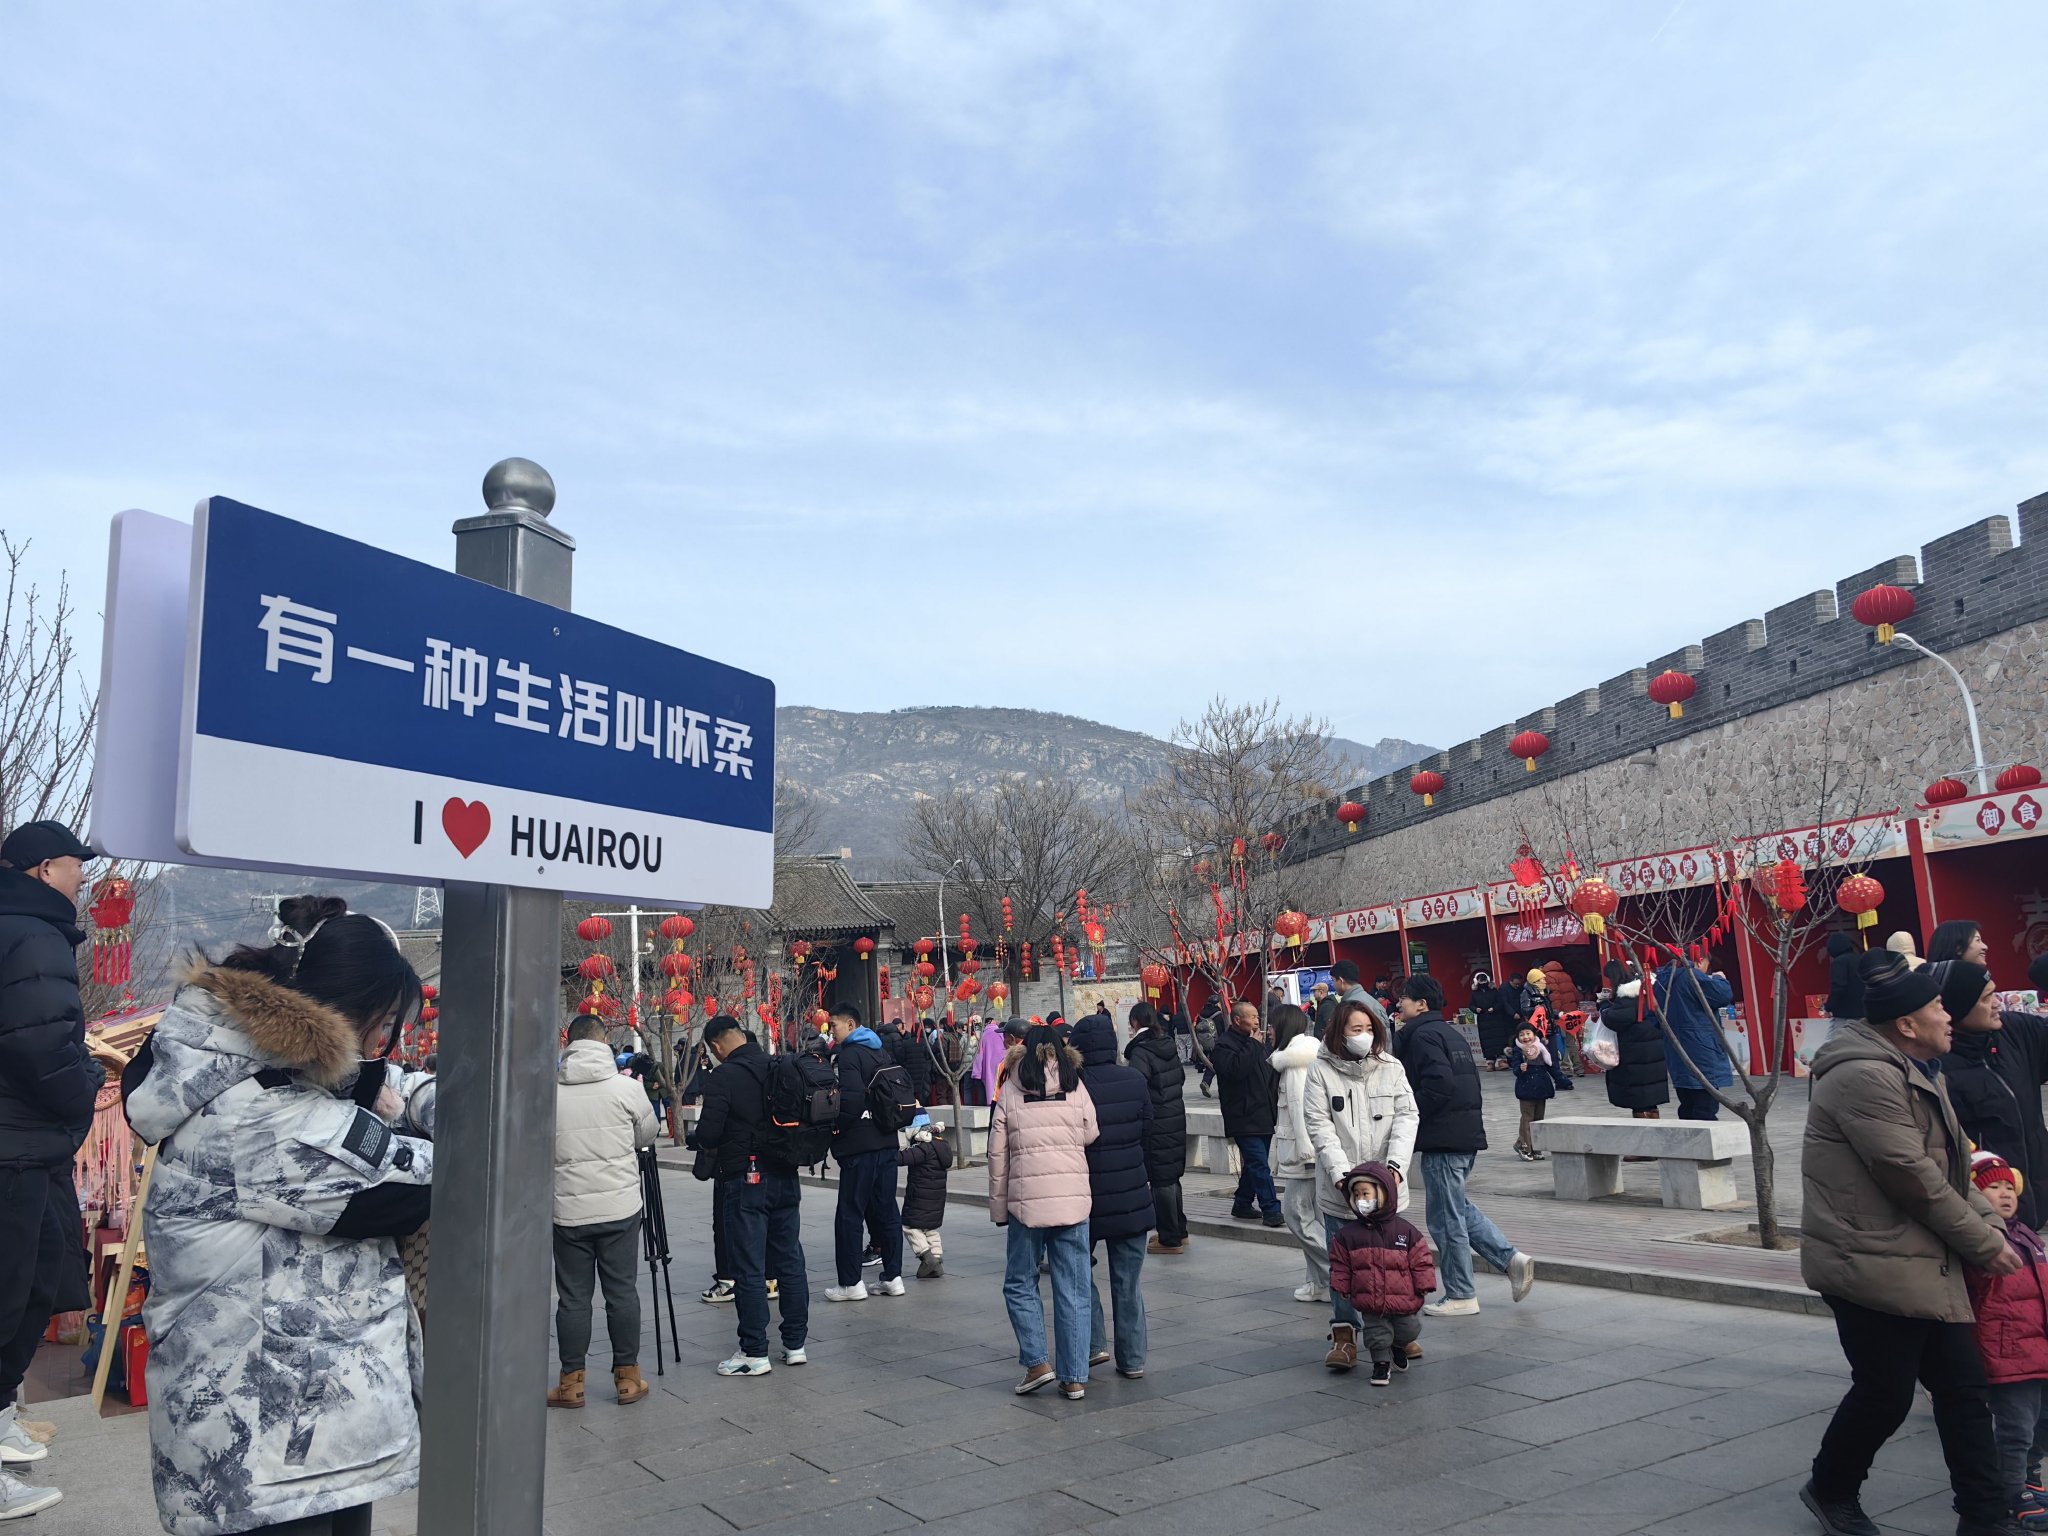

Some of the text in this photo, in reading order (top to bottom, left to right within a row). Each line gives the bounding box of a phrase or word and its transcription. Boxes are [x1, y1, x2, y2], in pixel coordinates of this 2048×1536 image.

[257, 595, 754, 781] 有一种生活叫怀柔
[413, 799, 663, 874] I HUAIROU
[1981, 801, 2036, 830] 御食
[1423, 899, 1457, 916] 丰宁县
